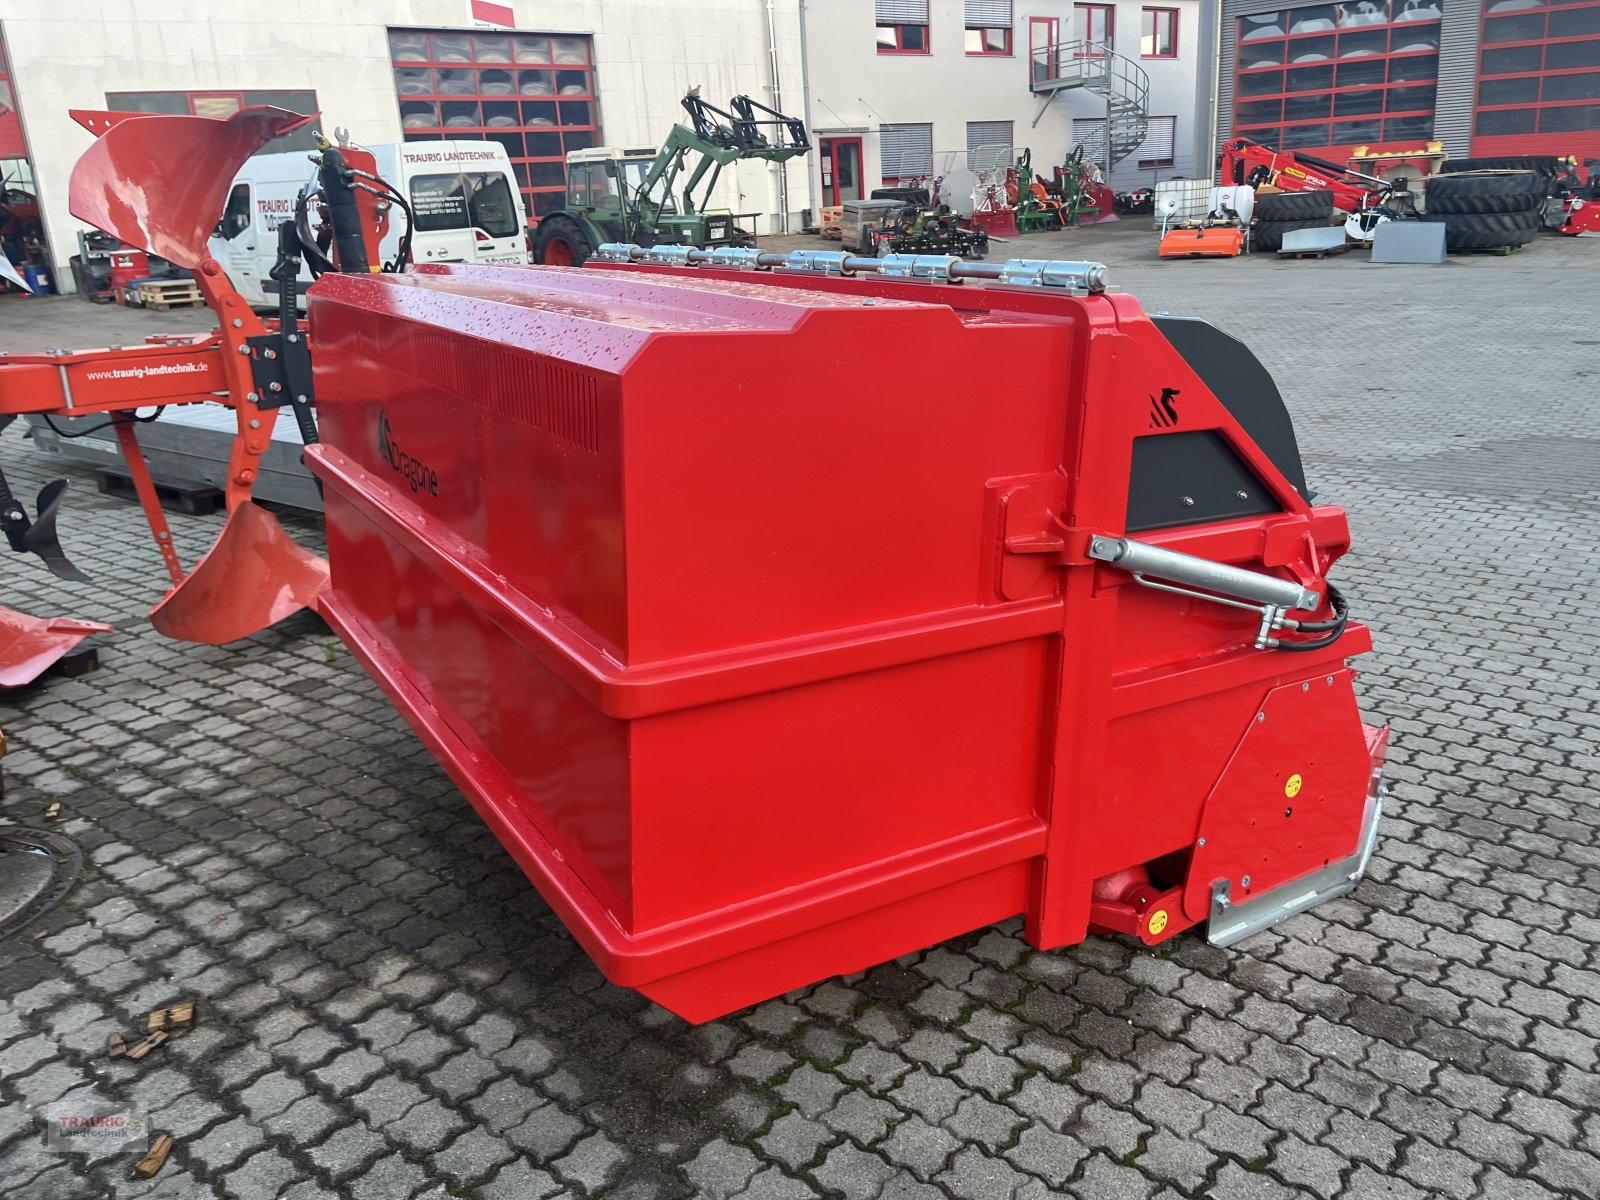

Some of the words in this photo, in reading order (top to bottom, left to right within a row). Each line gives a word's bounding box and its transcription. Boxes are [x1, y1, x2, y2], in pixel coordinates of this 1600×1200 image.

[404, 153, 442, 163] TRAURIG
[444, 152, 496, 161] LANDTECHNIK
[258, 199, 289, 213] TRAURIG
[87, 362, 208, 380] www.traurig-landtechnik.de
[391, 441, 438, 497] Dragone
